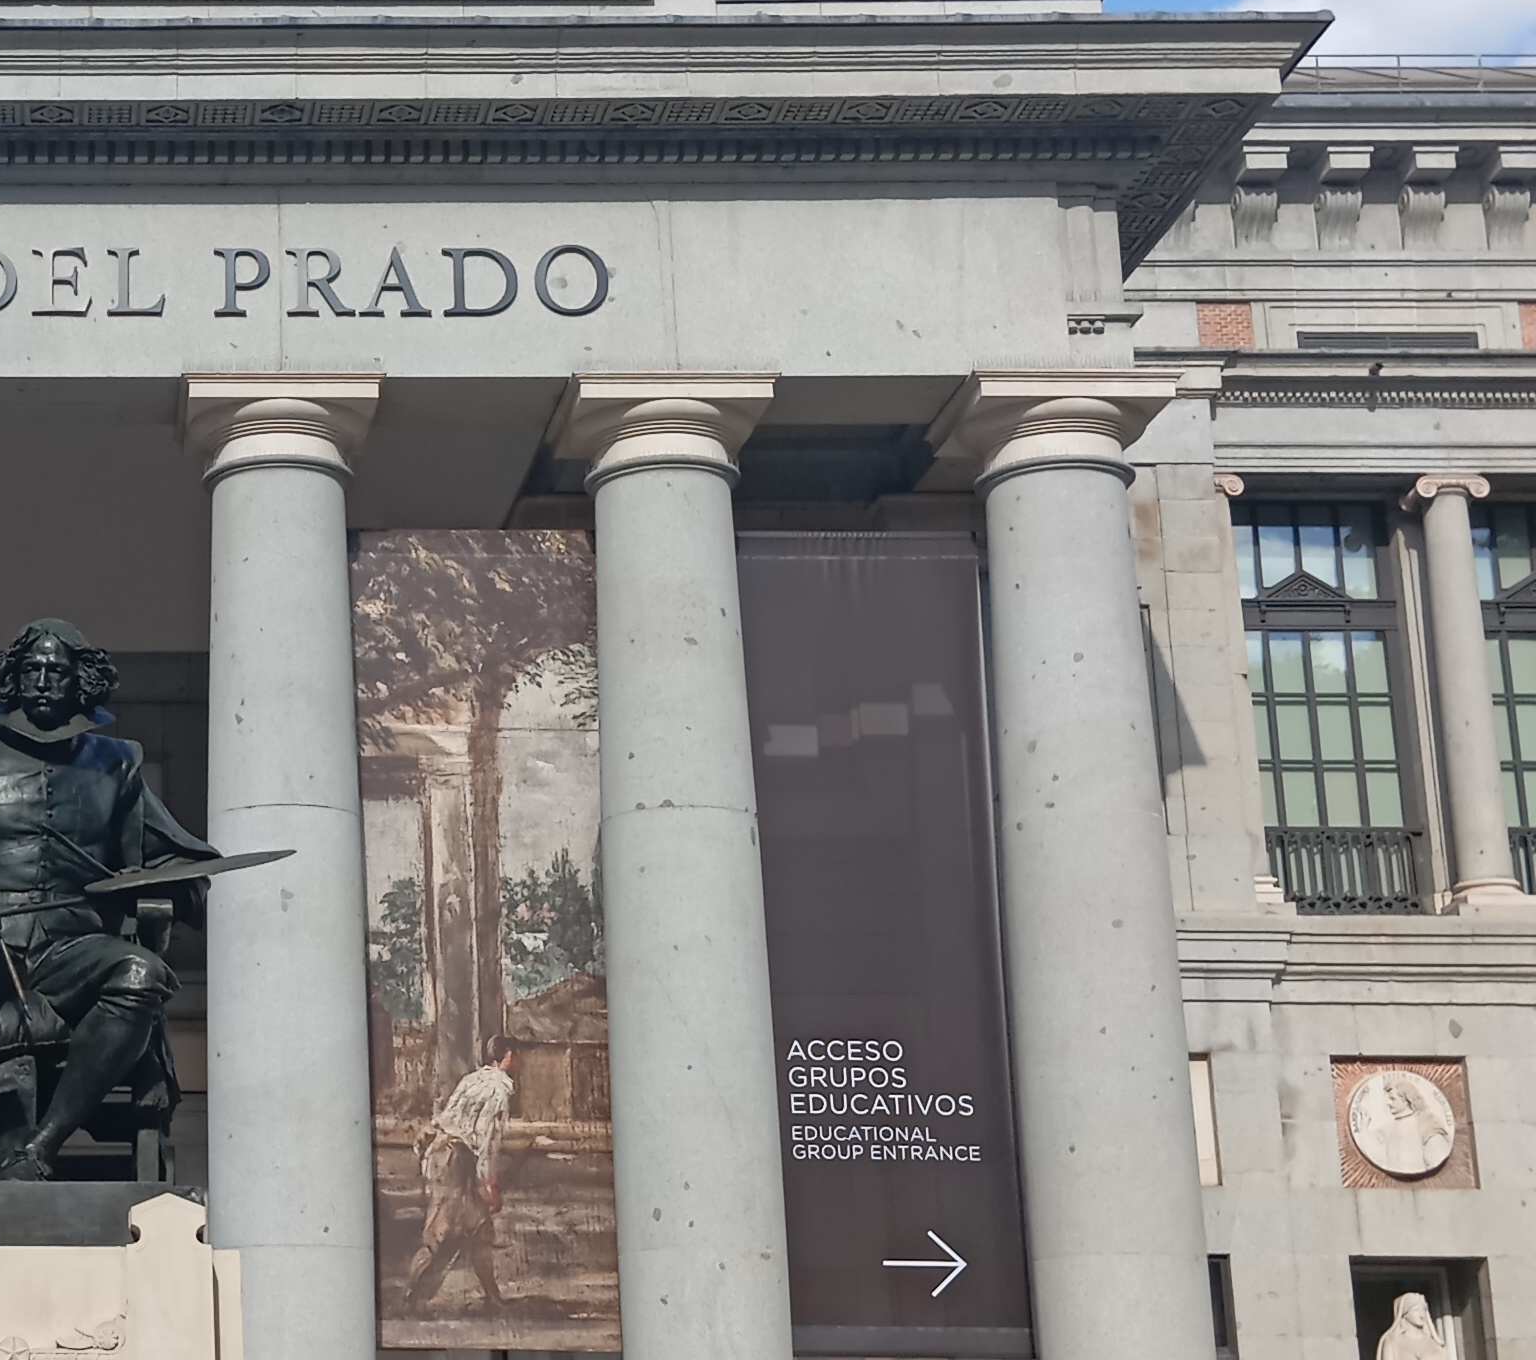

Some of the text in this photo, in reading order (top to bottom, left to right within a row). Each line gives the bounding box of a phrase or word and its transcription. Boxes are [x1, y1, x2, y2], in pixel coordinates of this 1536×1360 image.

[212, 243, 615, 319] PRADO
[787, 1040, 904, 1062] ACCESO
[788, 1067, 907, 1089] GRUPOS
[790, 1094, 974, 1117] EDUCATIVOS
[791, 1125, 937, 1142] EDUCATIONAL
[792, 1144, 982, 1161] GROUP ENTRANCE
